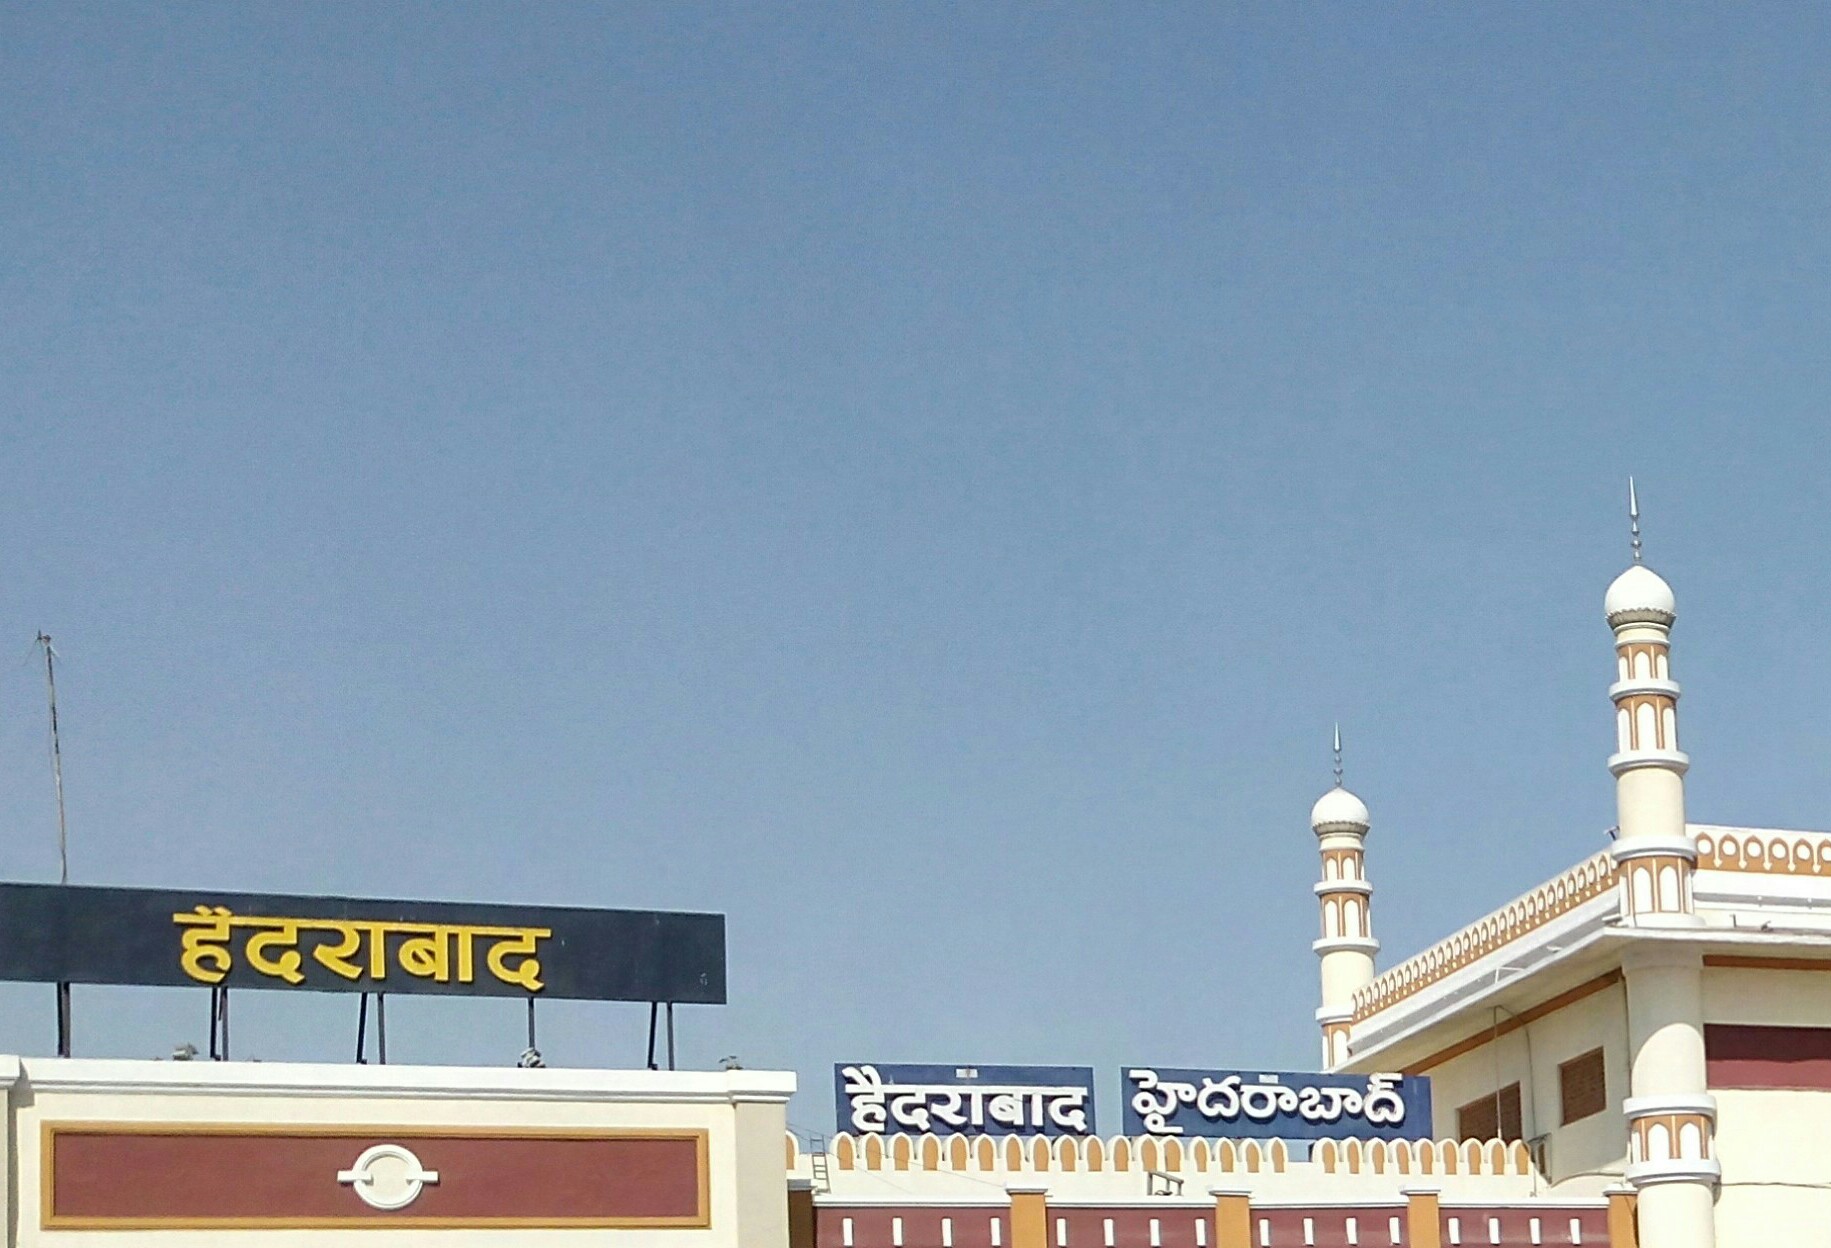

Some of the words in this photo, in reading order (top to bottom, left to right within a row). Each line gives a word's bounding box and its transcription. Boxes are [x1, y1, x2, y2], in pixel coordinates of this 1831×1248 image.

[173, 904, 551, 991] हैदराबाद
[842, 1064, 1088, 1133] हैदराबाद
[1128, 1068, 1405, 1134] హైదరాబాద్
